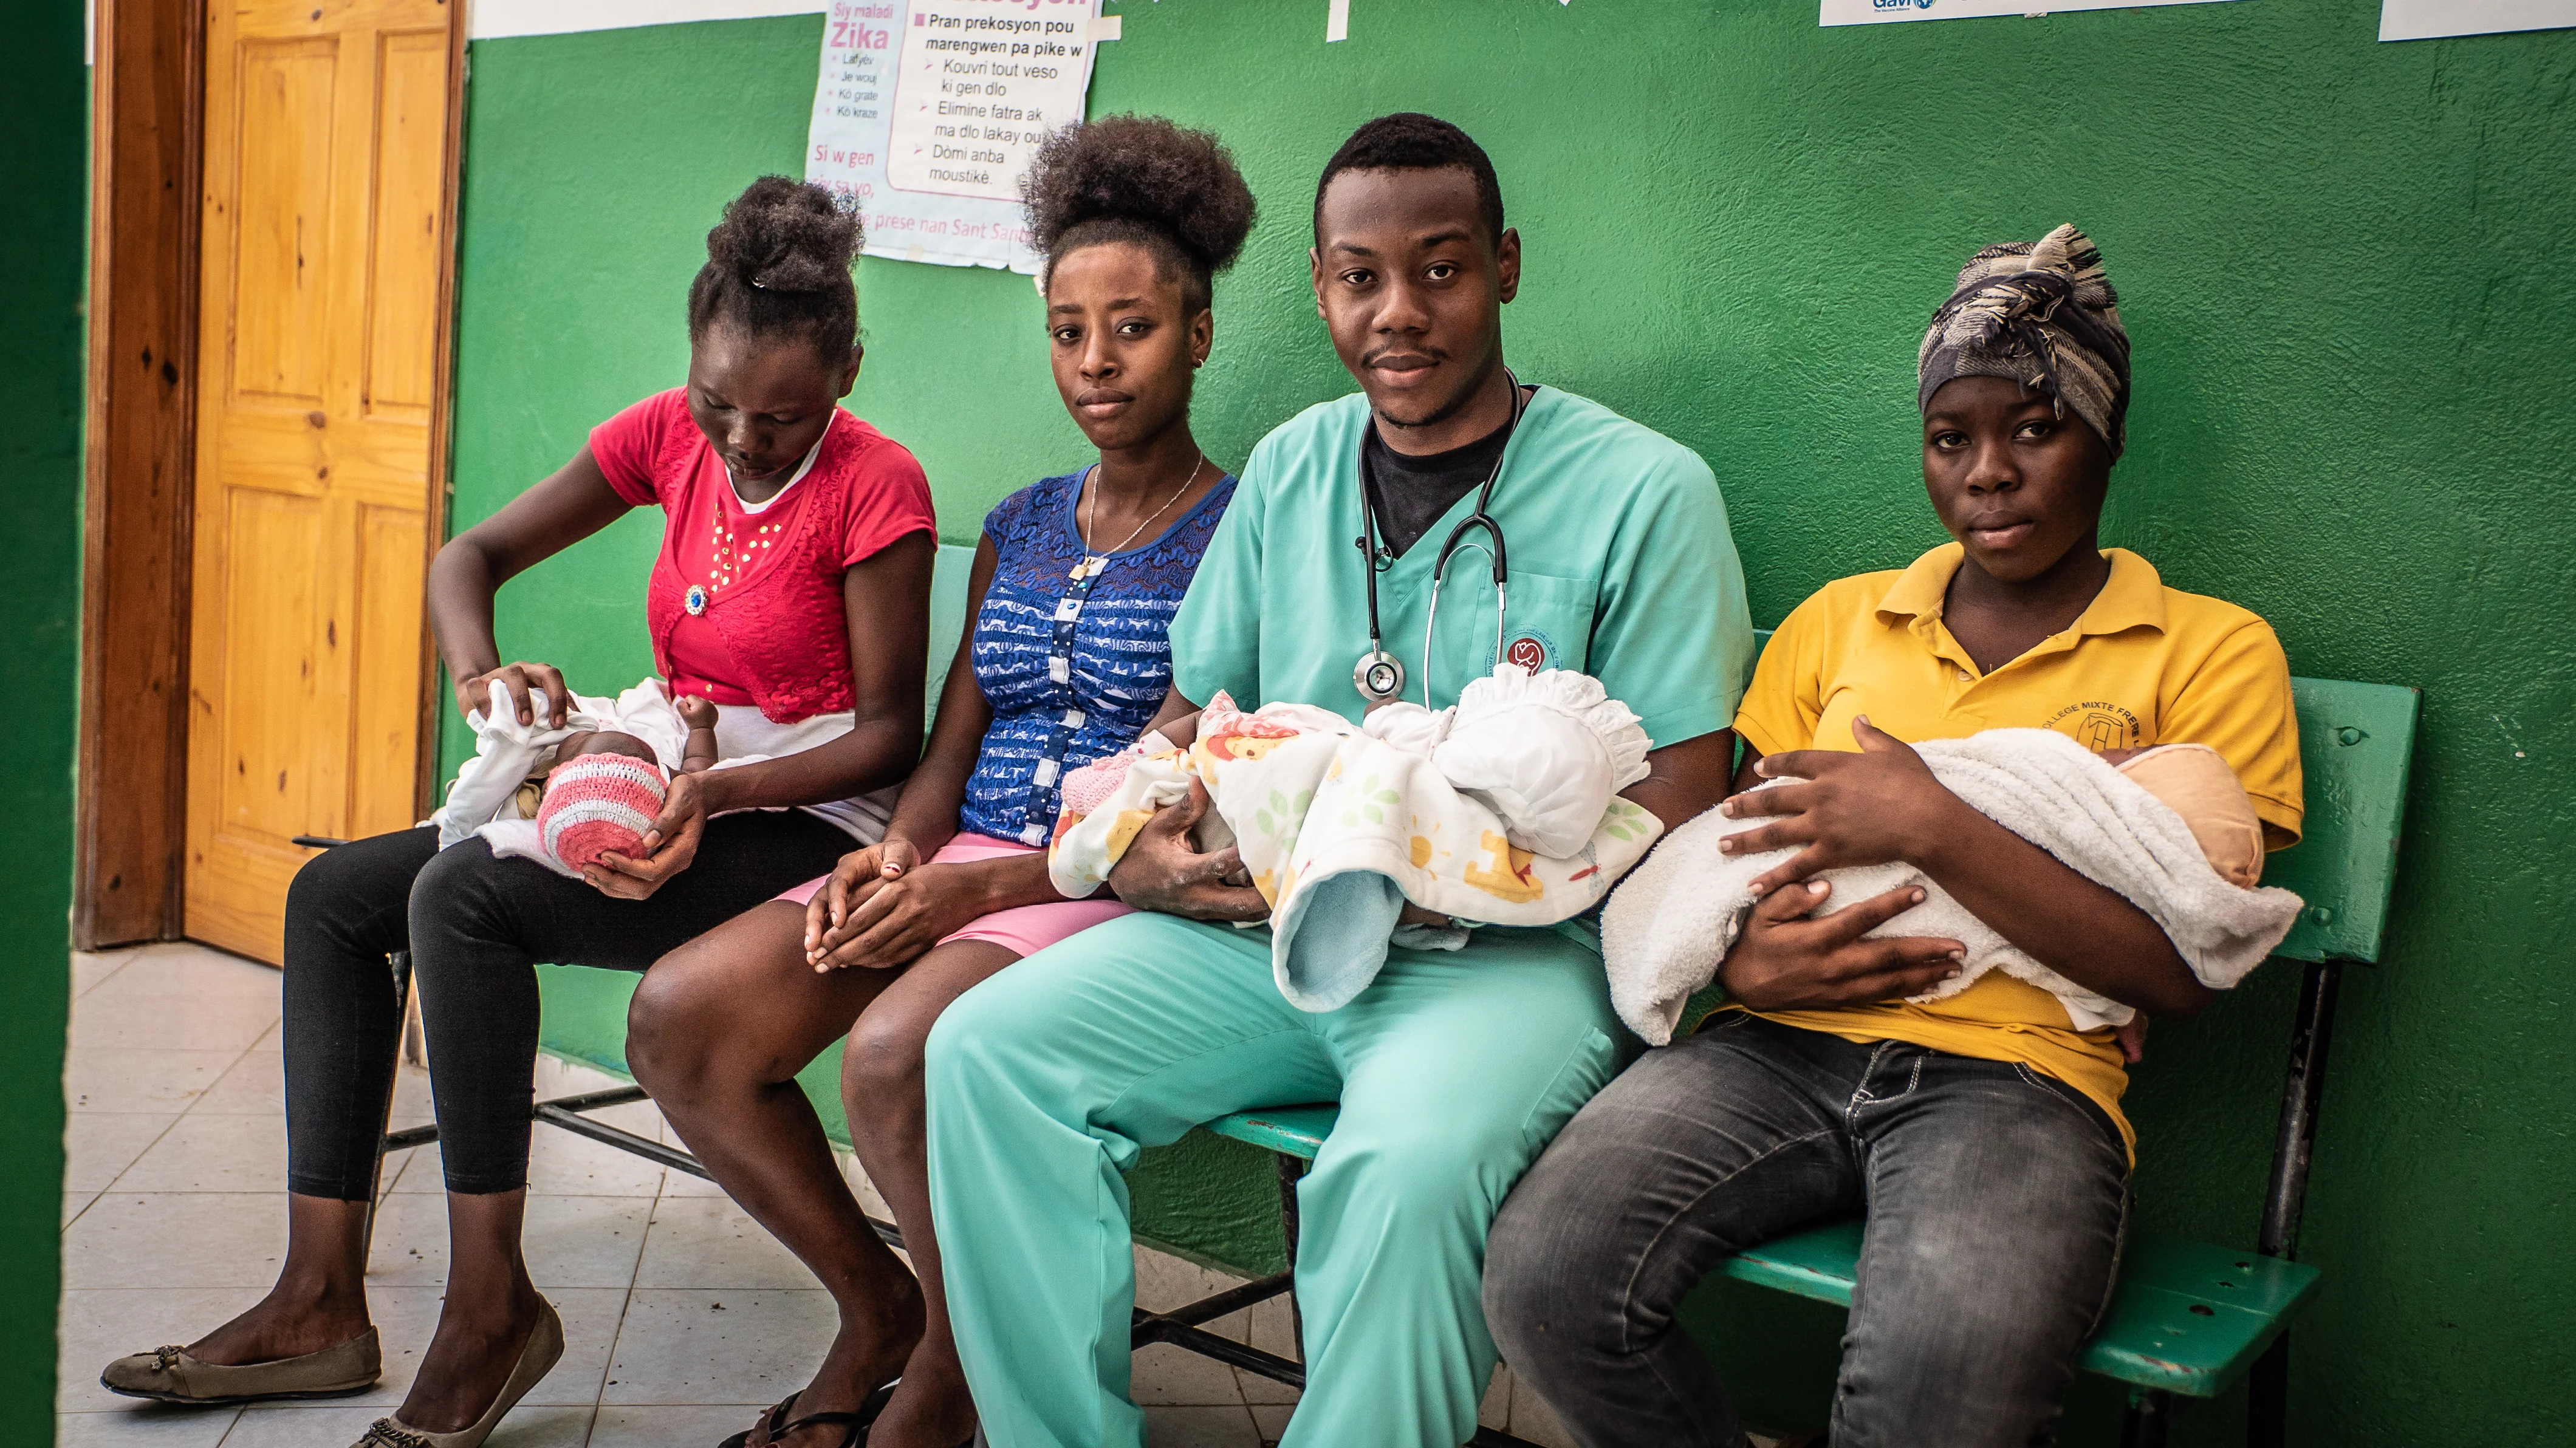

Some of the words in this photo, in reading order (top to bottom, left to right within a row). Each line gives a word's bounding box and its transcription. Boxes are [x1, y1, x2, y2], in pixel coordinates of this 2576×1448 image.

[834, 2, 851, 21] Siy
[854, 3, 894, 18] maladi
[930, 14, 961, 28] Pran
[965, 16, 1041, 34] prekosyon
[1045, 21, 1074, 35] pou
[831, 22, 889, 49] Zika
[926, 39, 1007, 54] marengwen
[1011, 43, 1029, 56] pa
[1034, 42, 1066, 57] pike
[1070, 46, 1083, 57] w
[841, 70, 853, 82] Je
[856, 72, 877, 85] wouj
[944, 59, 988, 74] Kouvri
[992, 62, 1018, 77] tout
[1023, 66, 1058, 79] veso
[854, 90, 879, 103] grate
[942, 79, 953, 92] ki
[956, 83, 981, 97] gen
[985, 82, 1007, 96] dlo
[853, 107, 879, 118] kraze
[938, 101, 987, 117] Elimine
[991, 104, 1023, 120] fatra
[1027, 108, 1043, 121] ak
[934, 125, 955, 137] ma
[960, 125, 979, 139] dlo
[983, 126, 1021, 146] lakay
[815, 145, 828, 162] Si
[833, 151, 846, 163] w
[848, 152, 874, 168] gen
[971, 149, 1004, 164] anba
[875, 214, 915, 231] prese
[920, 219, 948, 234] nan
[952, 219, 987, 239] Sant
[2042, 704, 2080, 729] OLLEGE
[2081, 702, 2115, 711] MIXTE
[2116, 707, 2140, 738] FRERE
